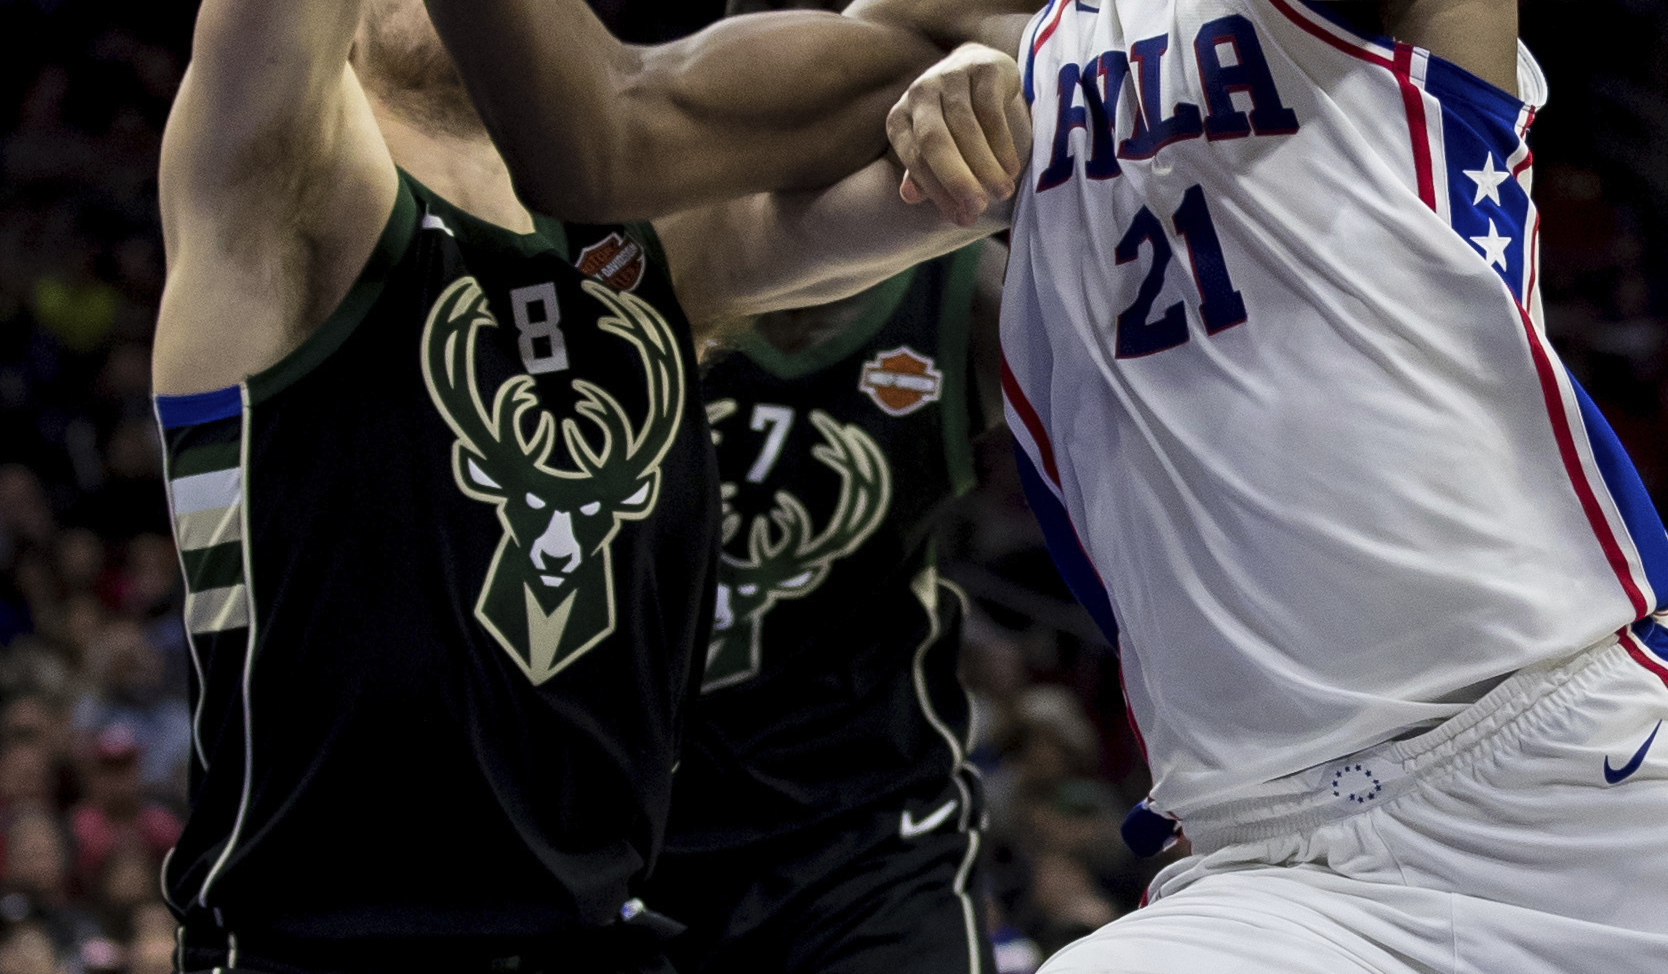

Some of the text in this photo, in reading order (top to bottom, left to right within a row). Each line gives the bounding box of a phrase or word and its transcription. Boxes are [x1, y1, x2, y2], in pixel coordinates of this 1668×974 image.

[1115, 184, 1247, 359] 21
[510, 282, 569, 375] 8
[749, 403, 795, 482] 7
